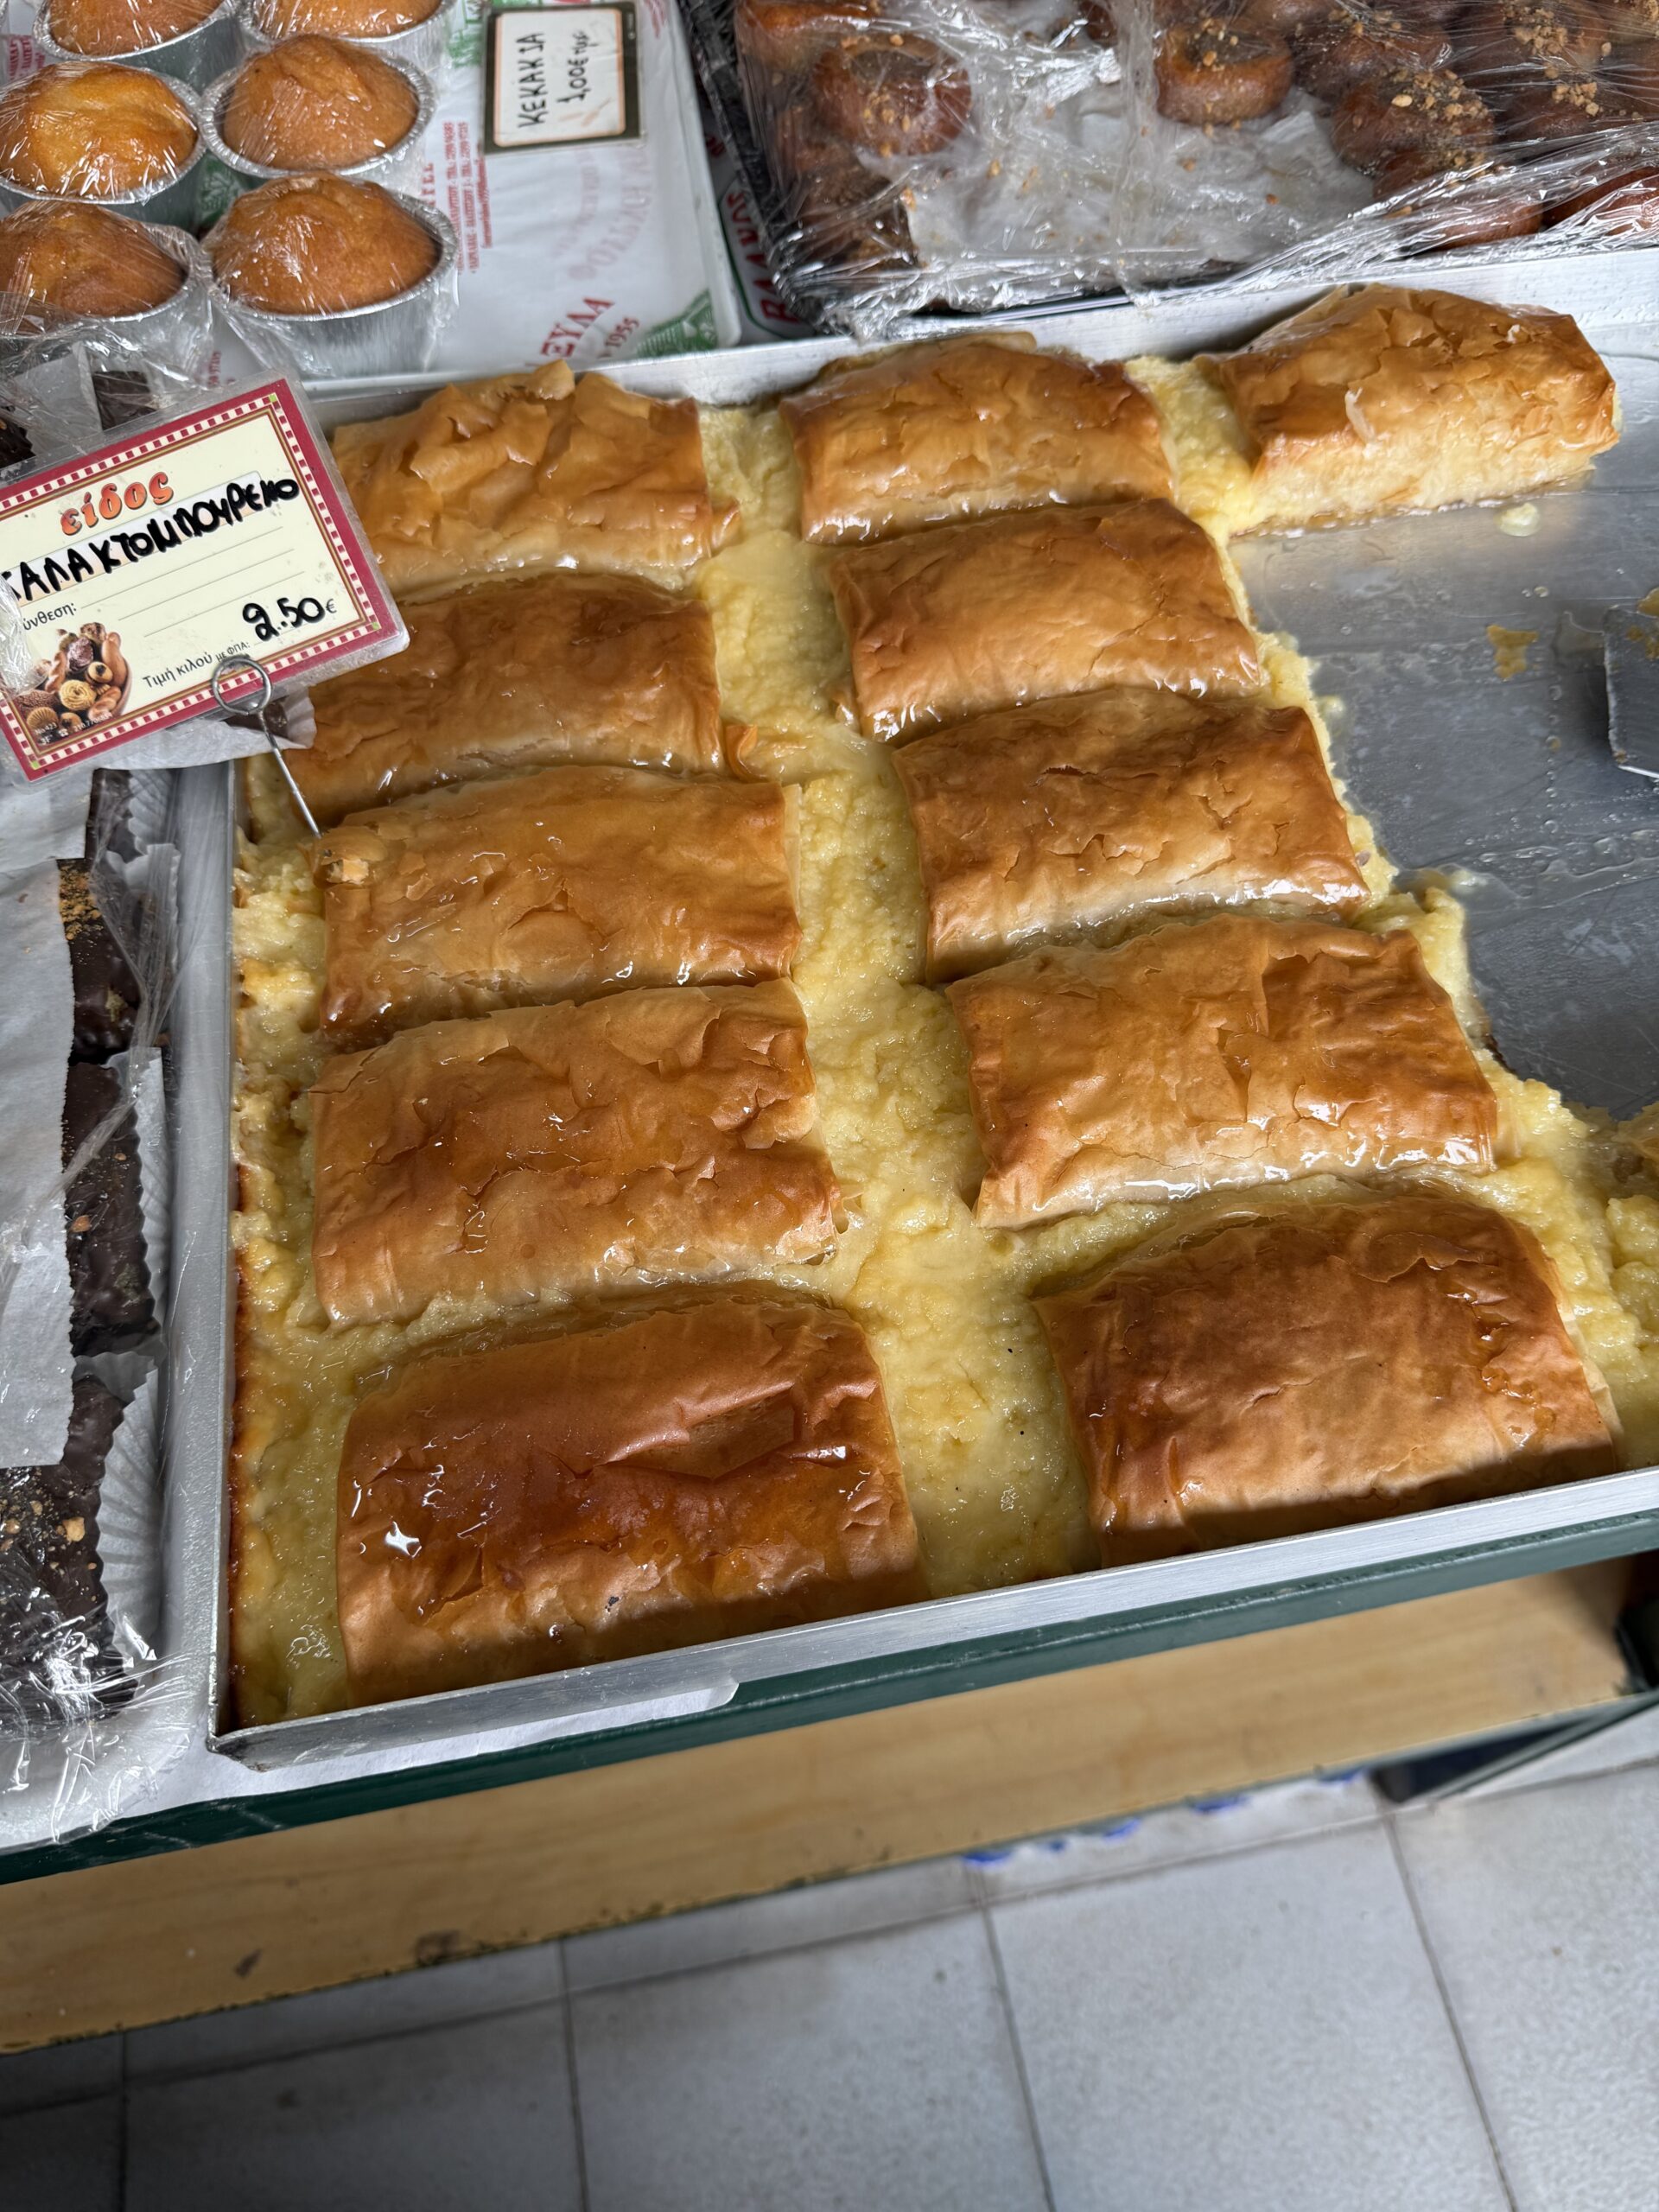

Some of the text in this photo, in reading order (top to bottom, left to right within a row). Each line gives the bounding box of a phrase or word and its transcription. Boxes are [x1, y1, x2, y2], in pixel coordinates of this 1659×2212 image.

[60, 472, 174, 536] είδος
[23, 602, 77, 631] ύνθεση:
[143, 667, 176, 688] Τιμή
[175, 652, 213, 676] κιλού
[226, 641, 251, 655] ΦΠΑ:
